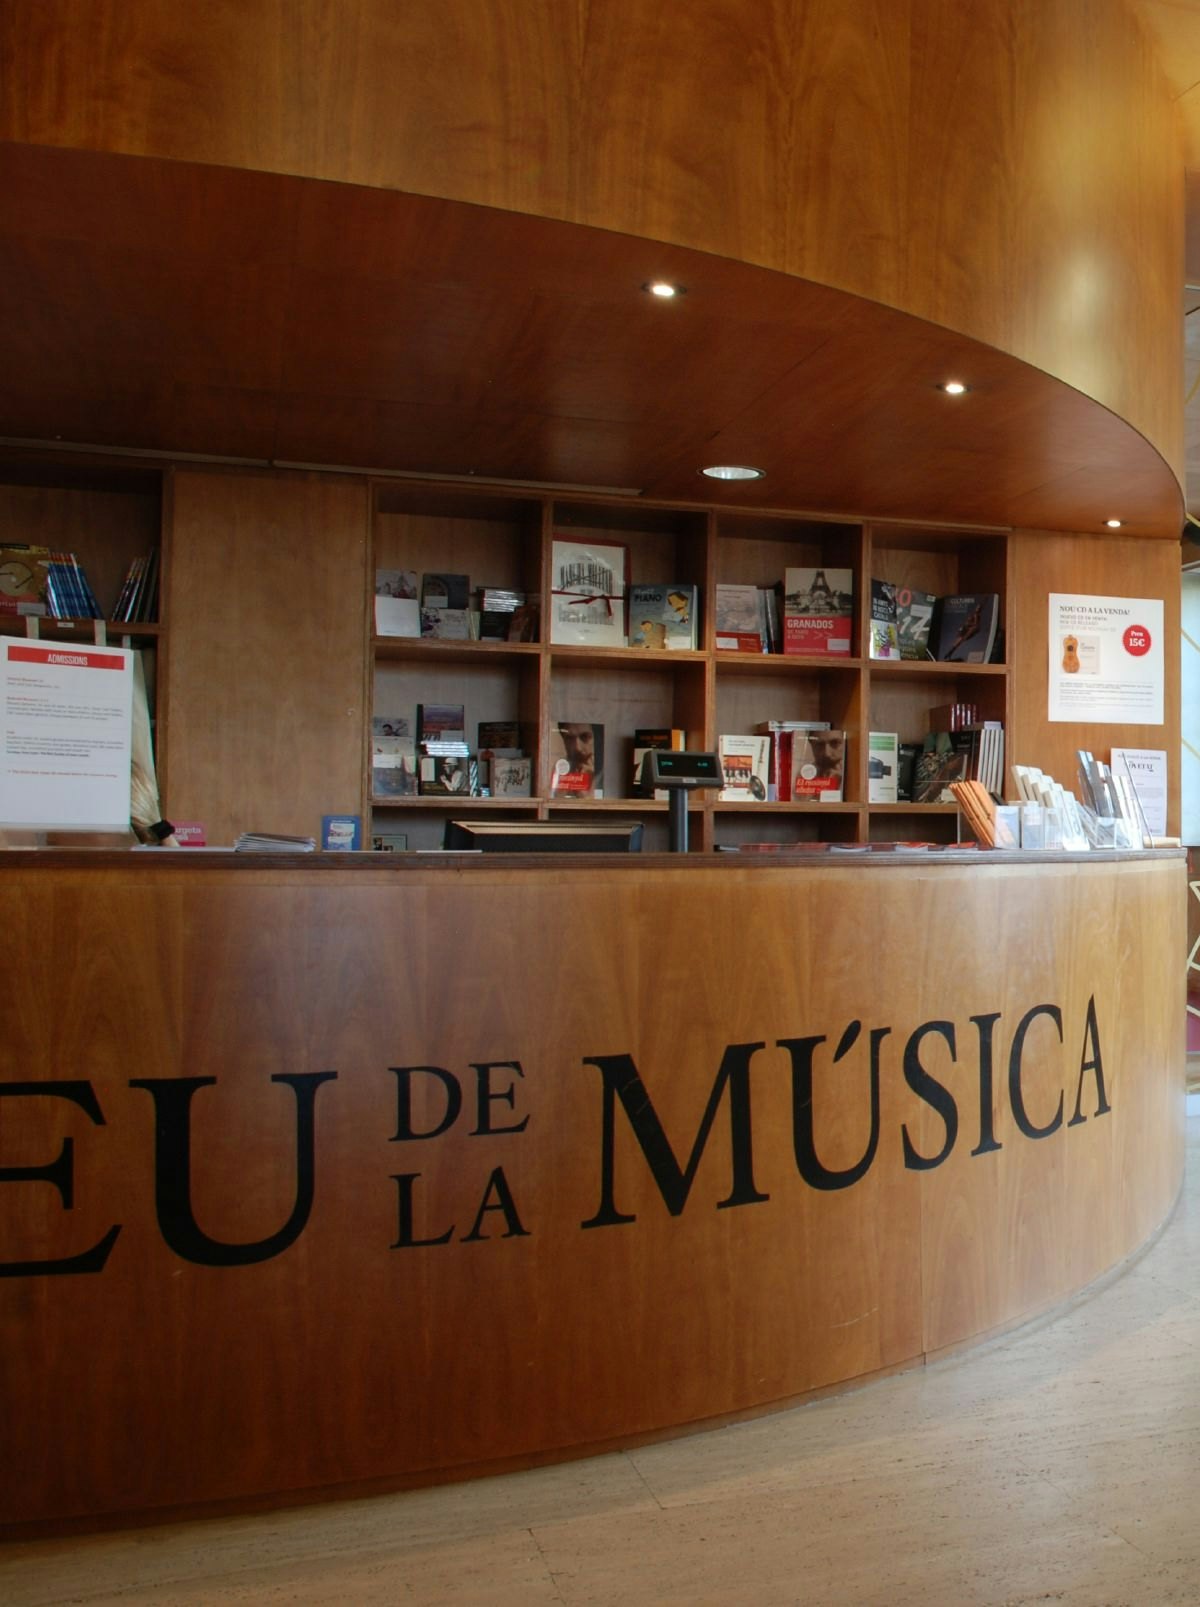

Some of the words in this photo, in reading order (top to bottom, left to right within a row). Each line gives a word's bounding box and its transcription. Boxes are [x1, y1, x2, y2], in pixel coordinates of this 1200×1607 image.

[1059, 605, 1075, 613] NOU
[786, 618, 834, 629] GRANADOS
[1129, 638, 1145, 647] 15€
[47, 653, 88, 666] ADMISSIONS
[389, 1060, 531, 1143] DE
[581, 994, 1112, 1231] MÚSICA
[389, 1167, 531, 1250] LA
